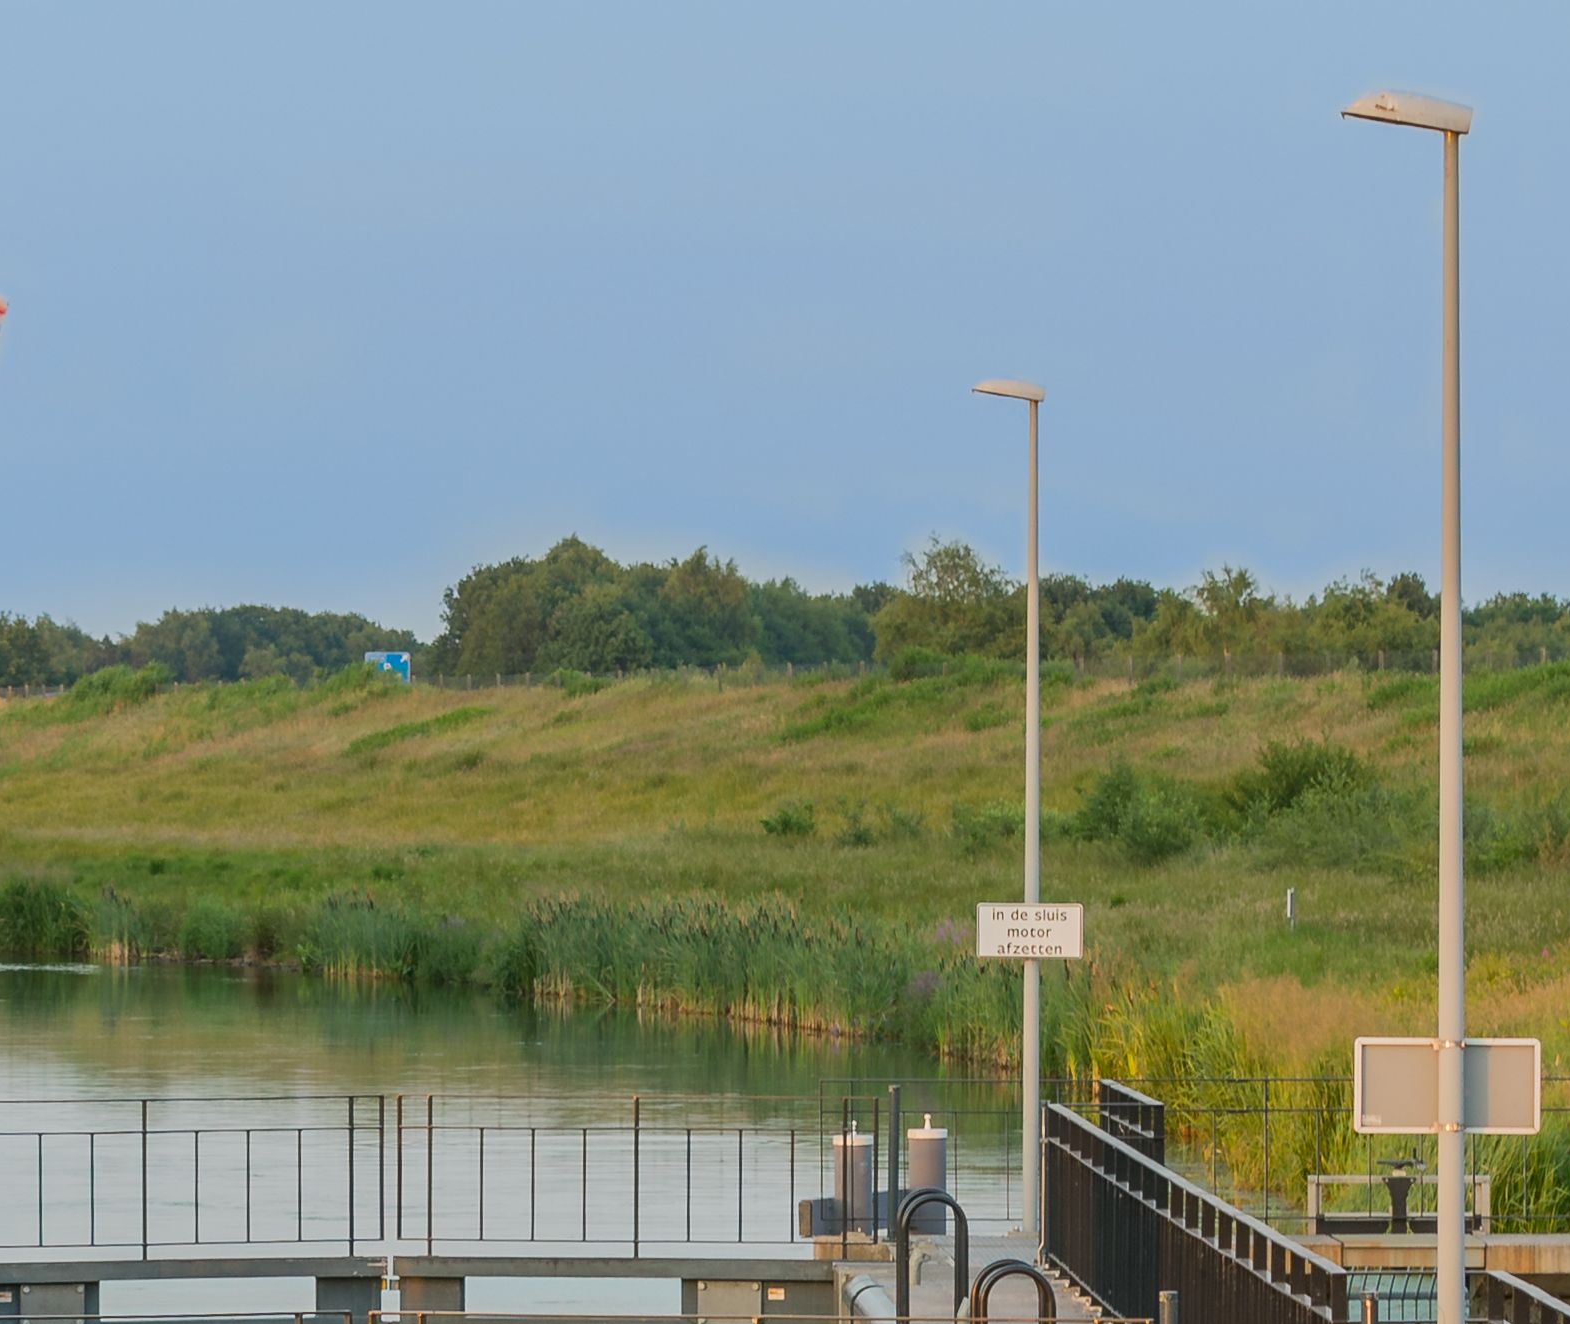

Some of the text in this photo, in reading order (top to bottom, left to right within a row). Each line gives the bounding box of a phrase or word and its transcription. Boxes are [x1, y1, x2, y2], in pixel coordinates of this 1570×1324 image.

[992, 908, 1068, 921] in de sluis
[1007, 927, 1052, 938] motor
[997, 942, 1062, 955] afzetten
